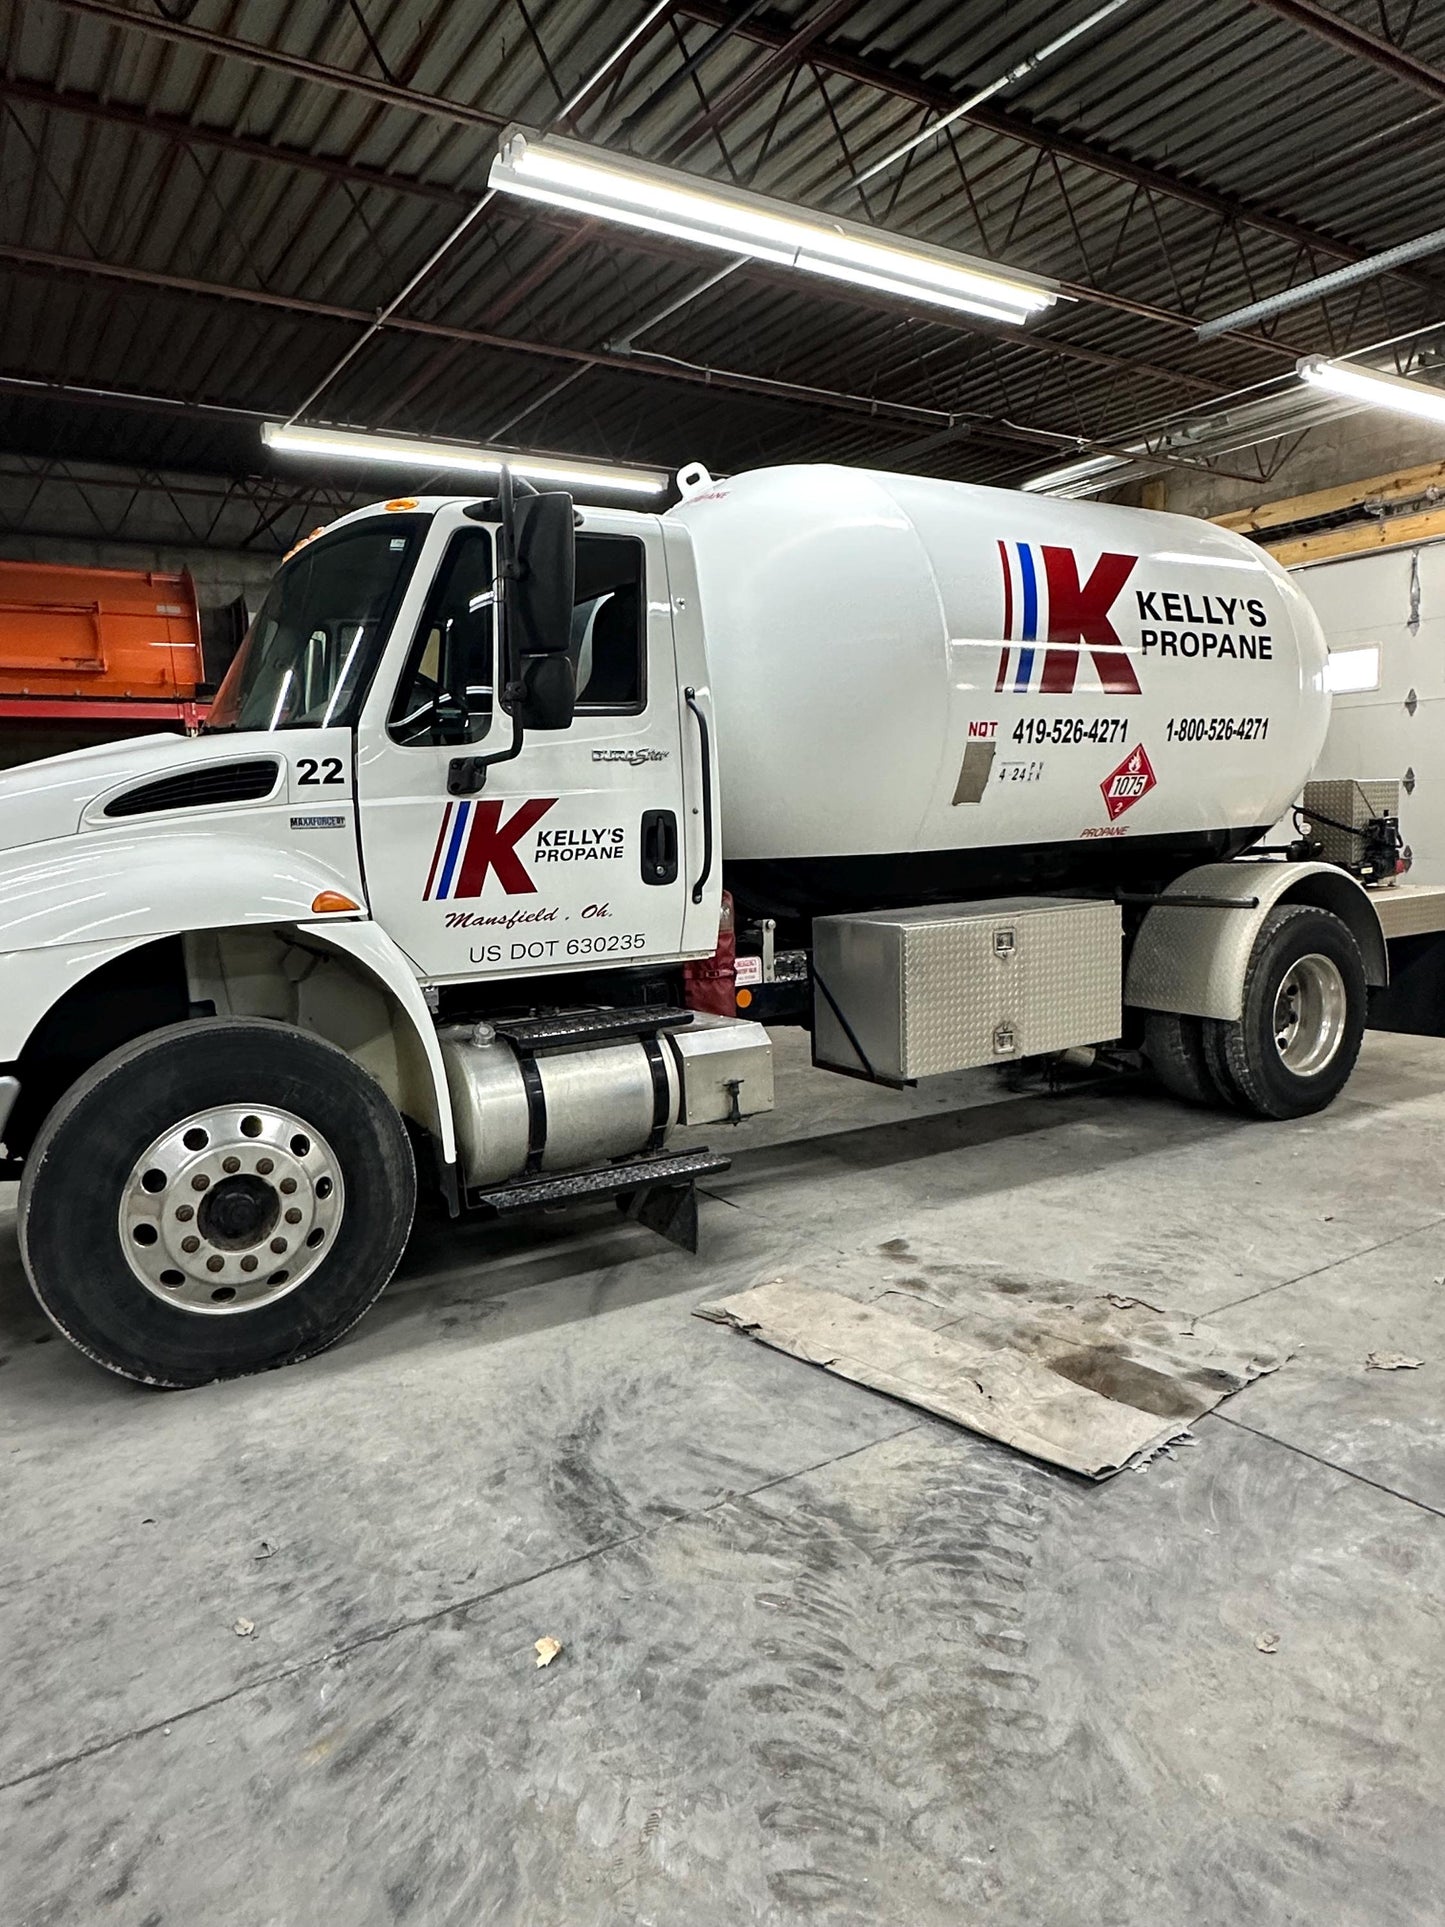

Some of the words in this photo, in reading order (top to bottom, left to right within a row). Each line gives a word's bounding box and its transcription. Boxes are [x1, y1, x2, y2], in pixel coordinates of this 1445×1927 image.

[1038, 544, 1143, 695] K
[1135, 590, 1267, 628] KELLY'S
[1140, 629, 1273, 660] PROPANE
[968, 721, 999, 738] NQT
[1012, 718, 1129, 744] 419-526-4271
[1166, 717, 1269, 742] 1-800-526-4271
[296, 757, 345, 786] 22
[1112, 776, 1146, 796] 1075
[1114, 801, 1123, 813] 2
[536, 827, 625, 848] KELLY'S
[1080, 825, 1130, 839] PROPANE
[453, 797, 560, 900] K
[534, 845, 624, 863] PROPANE
[444, 907, 560, 930] Mansfield
[580, 902, 614, 919] Oh.
[469, 945, 502, 964] US
[510, 940, 560, 960] DOT
[566, 933, 646, 955] 630235
